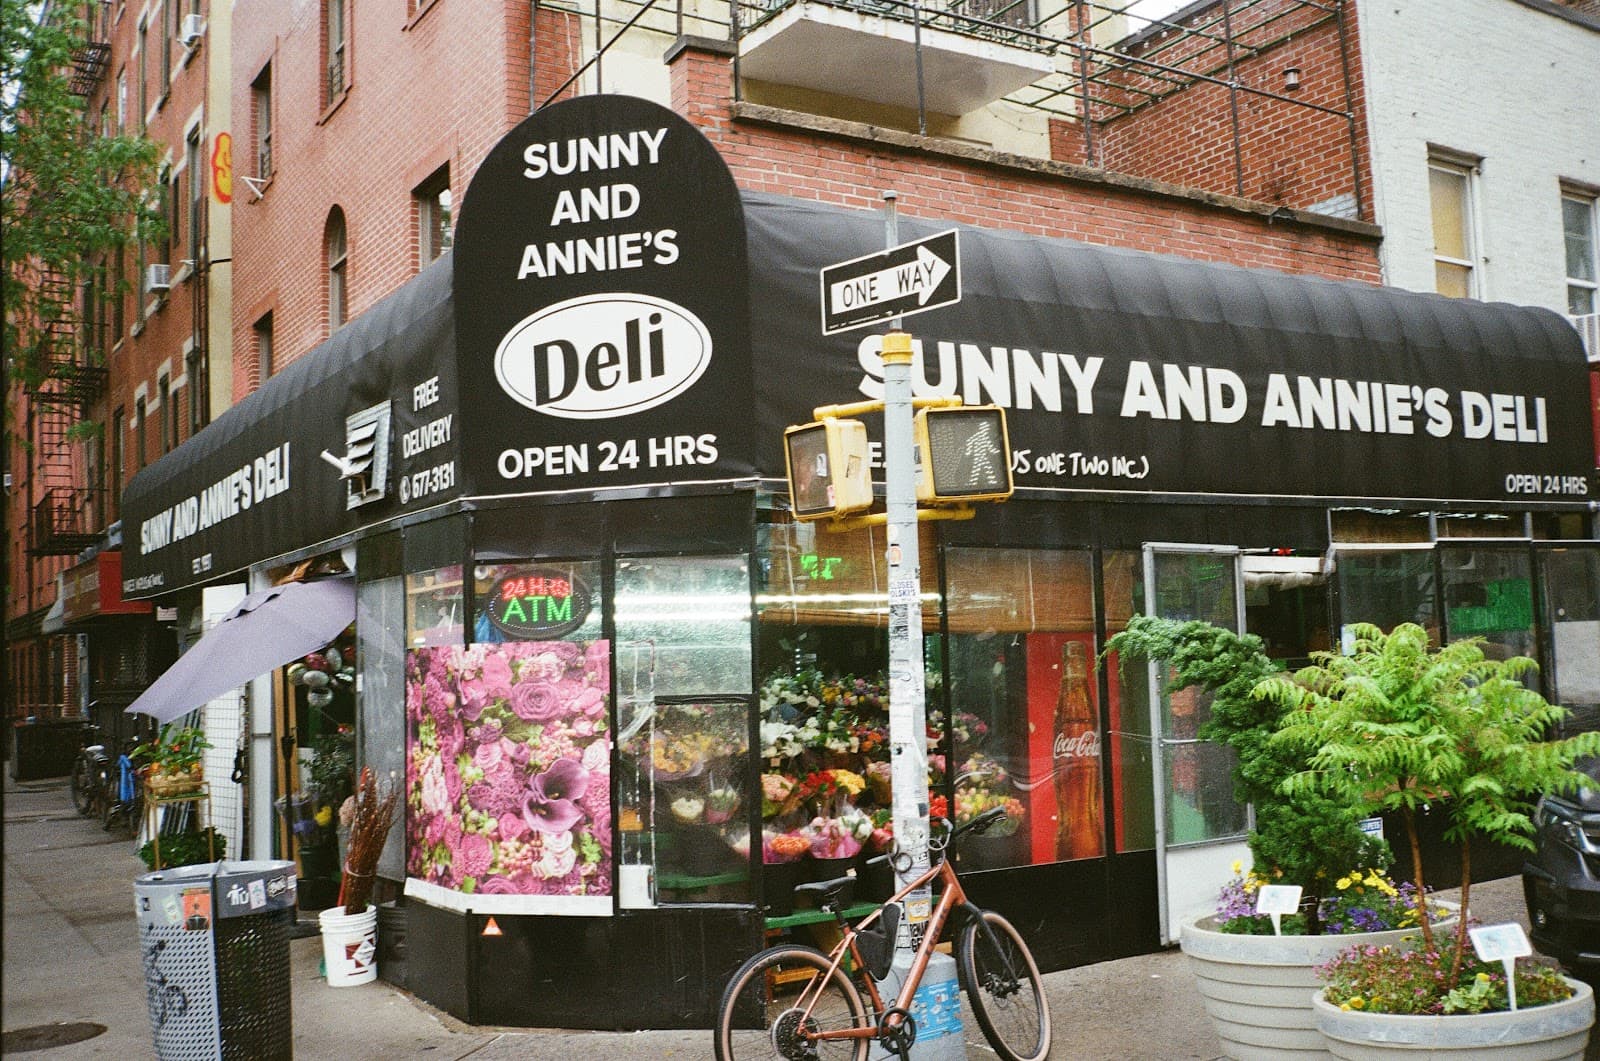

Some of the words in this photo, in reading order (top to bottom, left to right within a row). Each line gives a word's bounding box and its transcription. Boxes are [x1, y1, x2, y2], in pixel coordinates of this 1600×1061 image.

[523, 127, 668, 179] SUNNY
[550, 183, 640, 226] AND
[517, 229, 680, 280] ANNIE'S
[843, 276, 879, 307] ONE
[897, 260, 936, 294] WAY
[533, 312, 666, 407] Deli
[413, 375, 440, 412] FREE
[858, 334, 1104, 415] SUNNY
[1120, 360, 1248, 424] AND
[1261, 373, 1453, 438] ANNIE'S
[1460, 390, 1548, 444] DELI
[402, 413, 453, 459] DELIVERY
[497, 443, 589, 480] OPEN
[598, 439, 640, 471] 24
[648, 433, 719, 469] HRS
[412, 461, 455, 499] 677-3131
[1035, 452, 1067, 476] ONE
[1505, 473, 1541, 494] OPEN
[1543, 475, 1561, 495] 24
[1562, 476, 1588, 495] HRS
[140, 511, 173, 555] SUNNY
[172, 497, 198, 542] AND
[199, 464, 252, 529] ANNIE'S
[253, 441, 291, 505] DELI
[502, 595, 573, 624] ATM
[503, 578, 526, 601] 24
[1053, 730, 1100, 760] Coca-Cola
